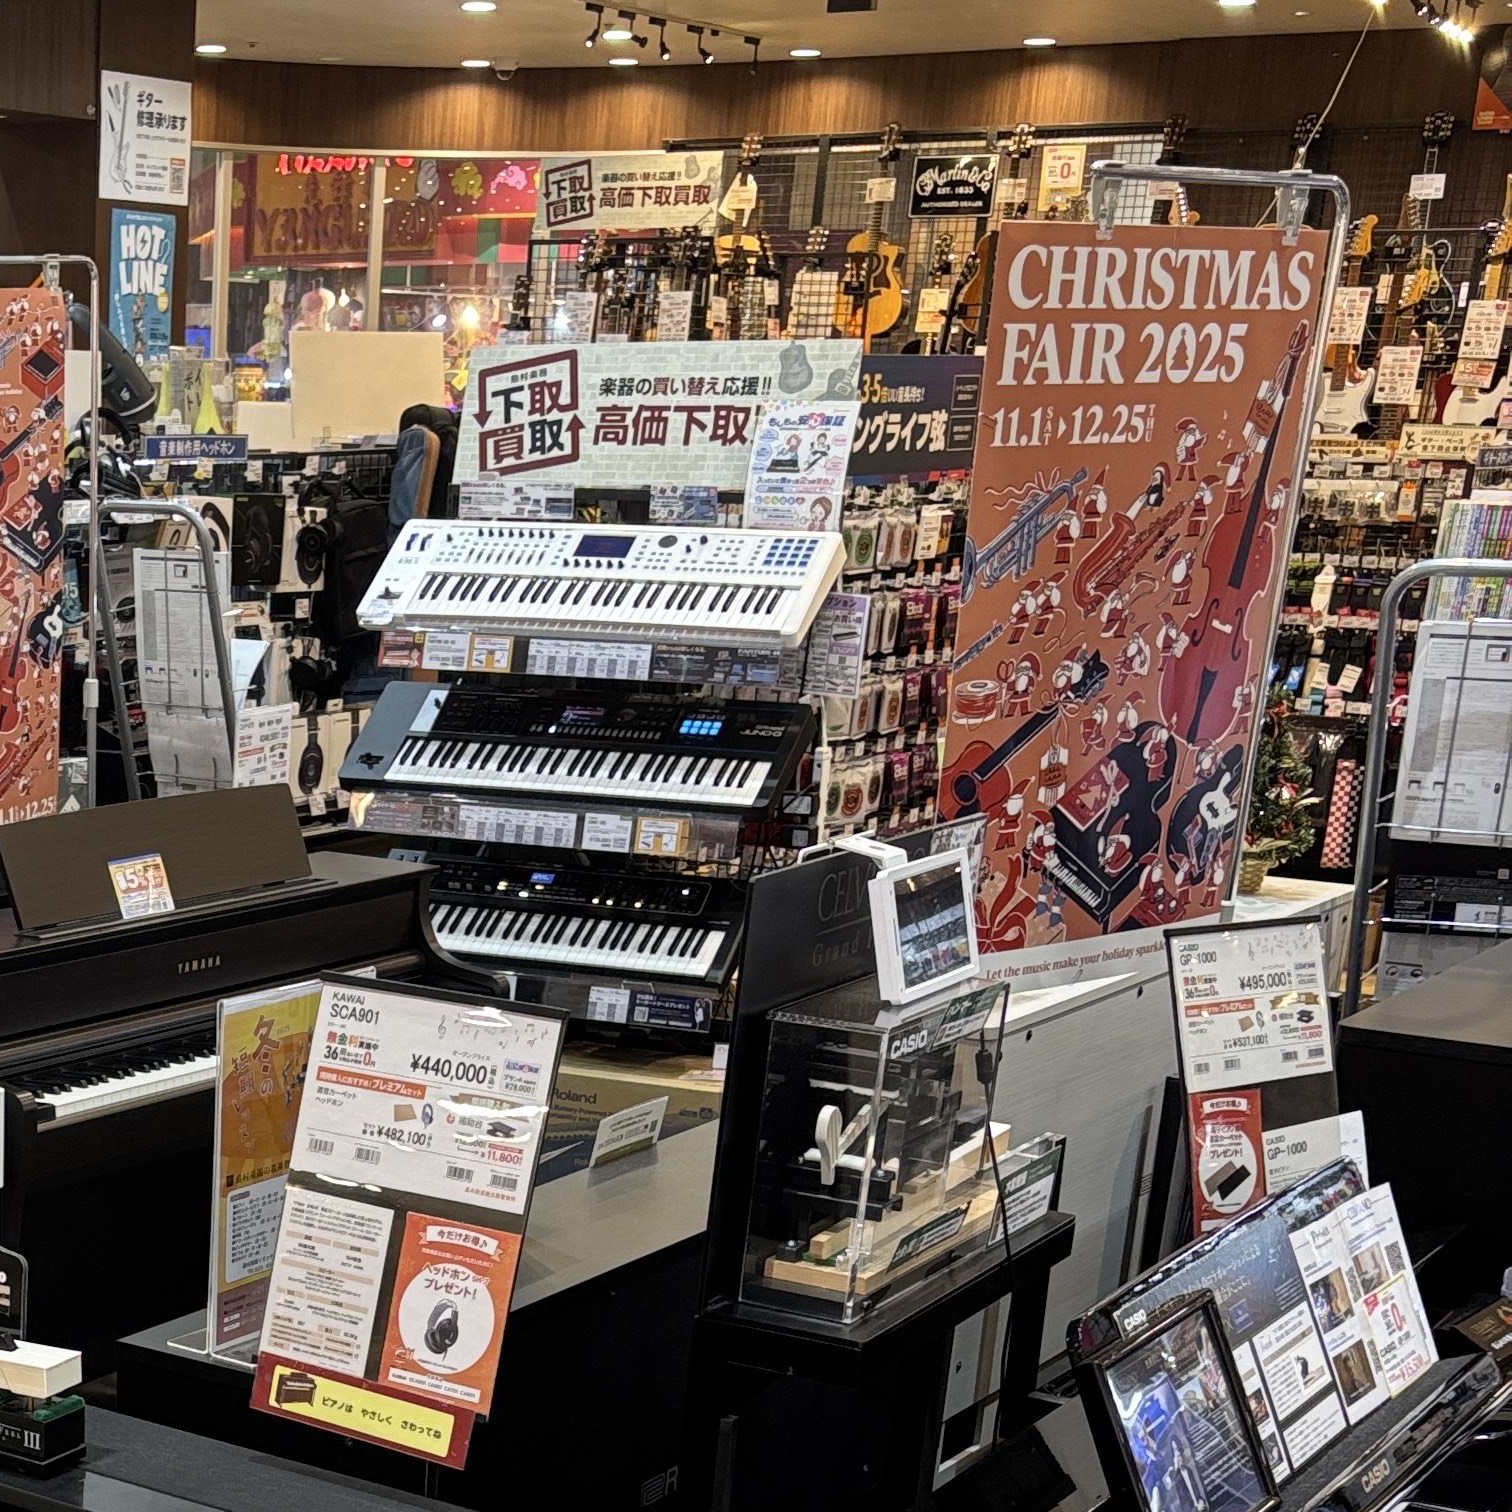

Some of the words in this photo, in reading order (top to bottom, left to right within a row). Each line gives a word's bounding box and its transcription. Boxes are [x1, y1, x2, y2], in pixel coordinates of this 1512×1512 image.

[136, 91, 163, 110] ギター
[136, 111, 188, 132] 修理承ります
[551, 174, 585, 198] 下取
[599, 184, 711, 209] 高価下取買取
[936, 187, 954, 195] EST.
[954, 186, 974, 195] 1833
[553, 195, 586, 219] 買取
[960, 200, 983, 208] DEALER
[119, 224, 166, 261] HOT
[118, 260, 169, 296] LINE
[1007, 243, 1314, 313] CHRISTMAS
[995, 322, 1126, 387] FAIR
[1133, 321, 1249, 385] 2025
[490, 379, 564, 425] 下取
[592, 404, 760, 448] 高価下取
[989, 406, 1043, 448] 11.1
[1067, 403, 1145, 446] 12.25
[158, 440, 236, 457] 音楽制作用ヘッドホン
[492, 418, 565, 466] 買取
[24, 795, 53, 820] 12.25
[177, 954, 221, 975] YAMAHA
[986, 968, 1002, 980] Let
[1003, 966, 1022, 978] the
[1023, 962, 1050, 976] music
[1052, 956, 1079, 971] make
[1079, 954, 1100, 968] your
[1102, 946, 1135, 963] holiday
[1238, 971, 1287, 992] ¥495,000
[331, 991, 366, 1006] KAWAI
[329, 1003, 381, 1026] SCA901
[890, 1029, 928, 1059] CASIO
[409, 1053, 488, 1085] ¥440,000
[314, 1096, 345, 1107] ヘッドホン
[553, 1088, 598, 1105] Roland
[376, 1123, 427, 1146] ¥482,100
[1266, 1134, 1286, 1147] CASIO
[1267, 1141, 1308, 1161] GP-1000
[424, 1262, 471, 1283] ヘッドホン
[423, 1277, 478, 1301] プレゼント!
[1123, 1310, 1148, 1332] CASIO
[321, 1394, 354, 1414] ピアノは
[361, 1405, 393, 1427] やさしく
[400, 1418, 443, 1441] さわってね
[1360, 1460, 1391, 1493] CASIO
